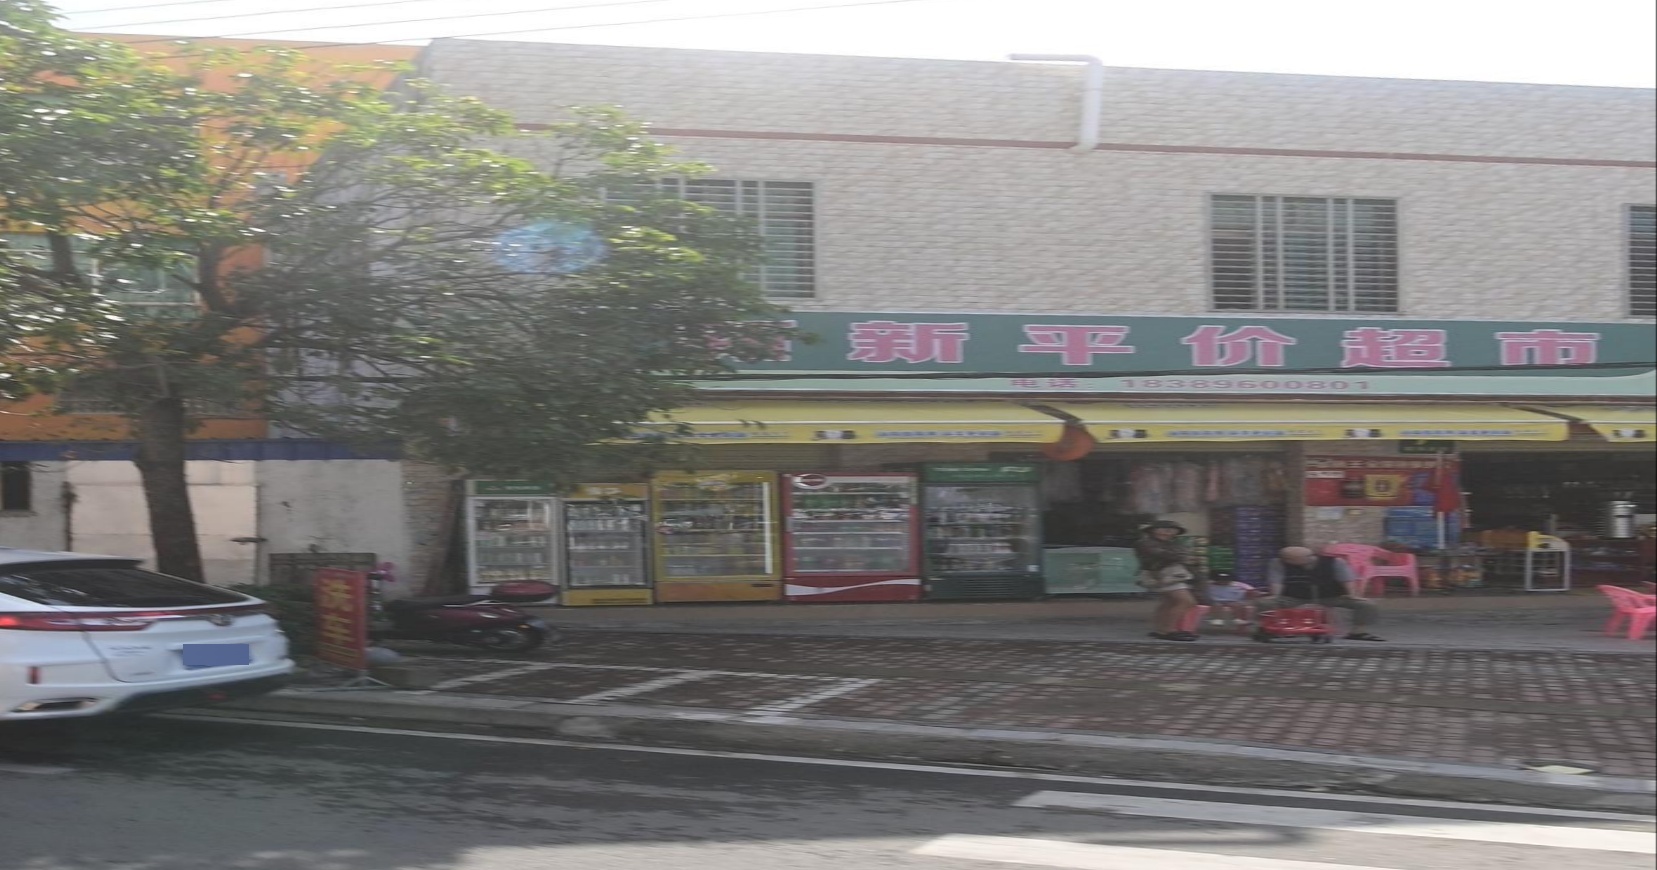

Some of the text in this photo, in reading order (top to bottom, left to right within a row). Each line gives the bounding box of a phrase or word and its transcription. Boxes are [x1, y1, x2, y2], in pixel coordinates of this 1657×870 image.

[676, 319, 1601, 368] 新平价超市
[1120, 378, 1372, 391] 18389600801
